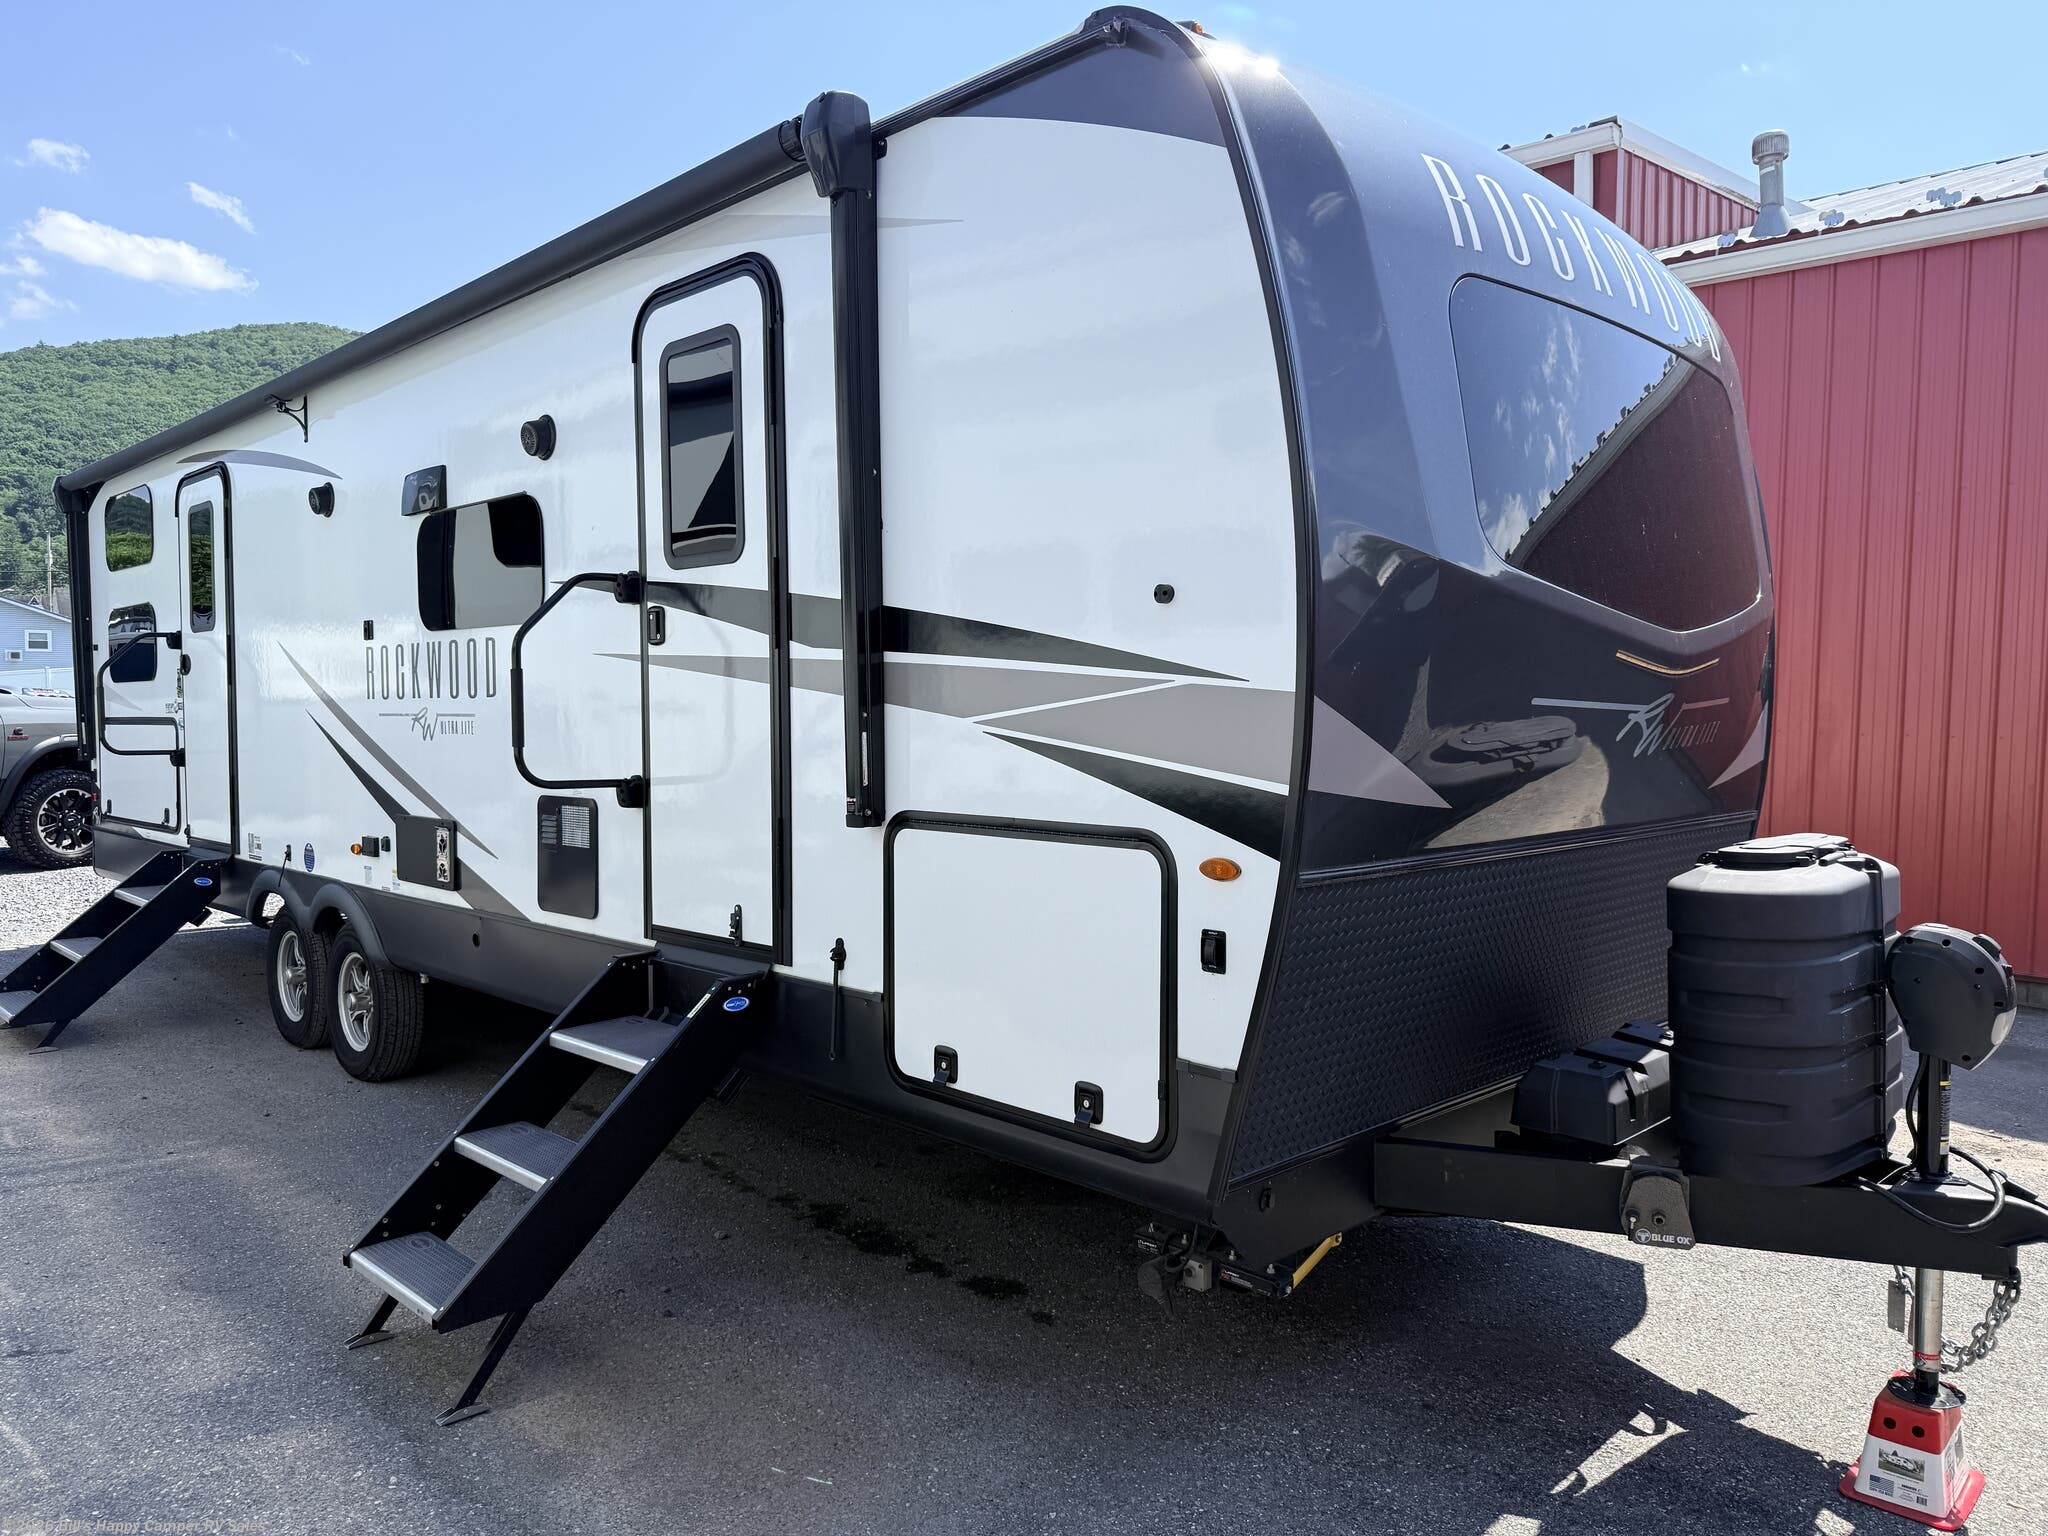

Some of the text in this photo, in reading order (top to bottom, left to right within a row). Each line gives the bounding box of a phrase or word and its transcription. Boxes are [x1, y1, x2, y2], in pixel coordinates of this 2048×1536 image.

[1421, 153, 1721, 362] ROCKWOOD
[367, 637, 497, 700] ROCKWOOD
[440, 721, 459, 735] ULTRA
[461, 721, 475, 735] LITE
[1651, 1233, 1691, 1245] BLUE OX
